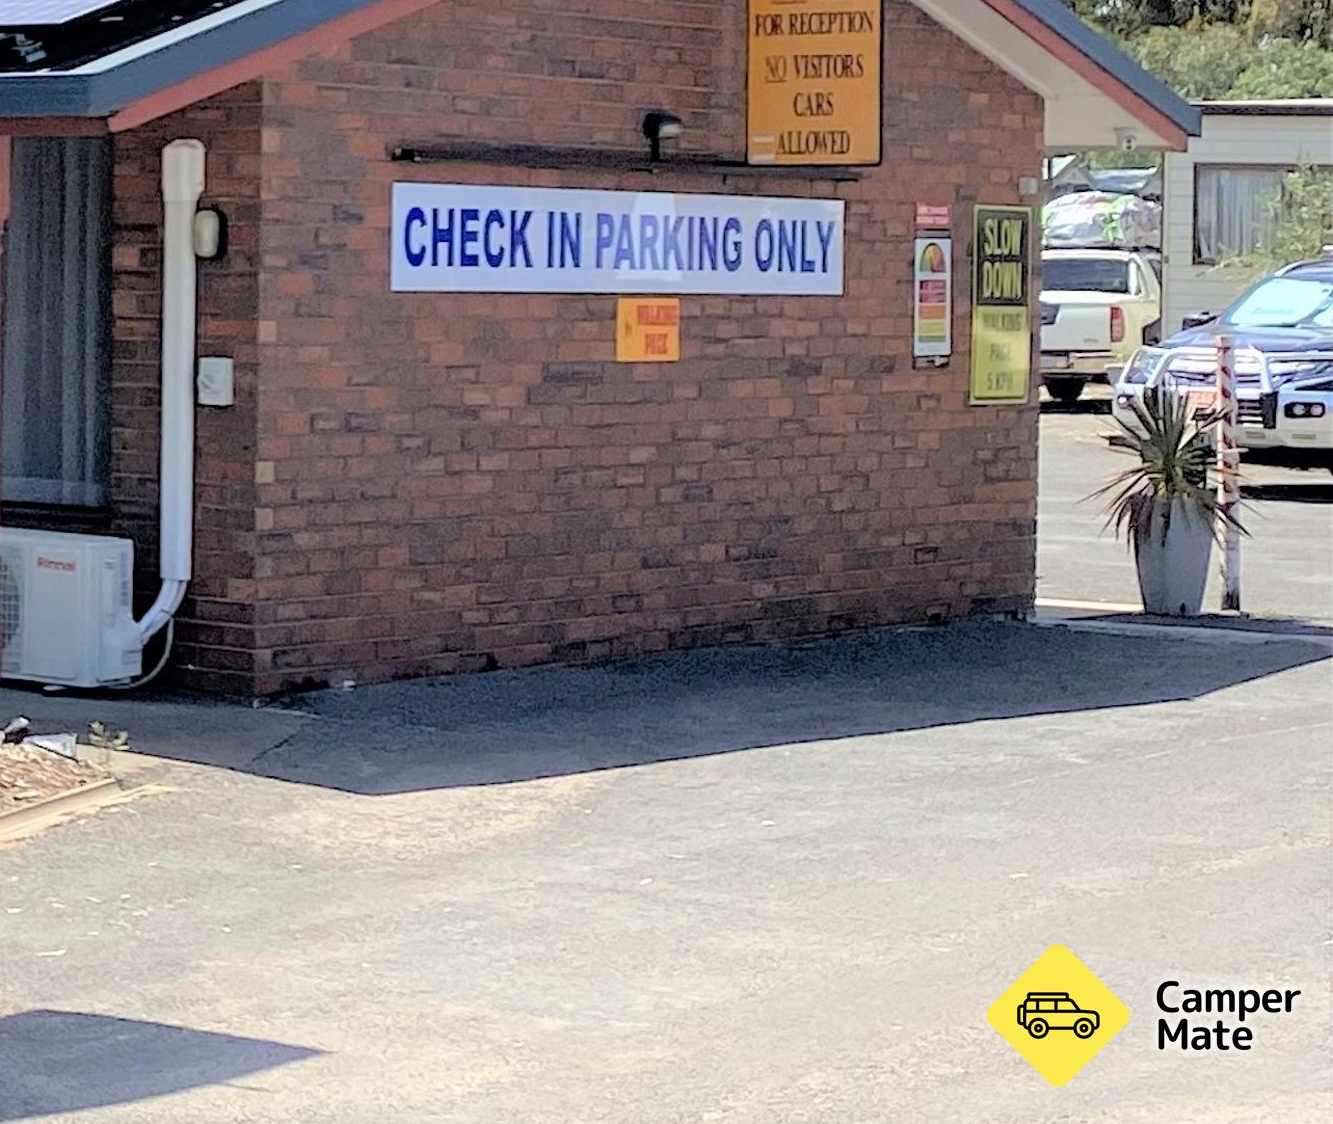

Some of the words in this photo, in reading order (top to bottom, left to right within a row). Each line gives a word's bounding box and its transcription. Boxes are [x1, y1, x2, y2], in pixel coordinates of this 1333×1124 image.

[755, 13, 785, 37] FOR
[788, 11, 876, 37] RECEPTION
[765, 55, 787, 79] NO
[793, 54, 865, 79] VISITORS
[793, 92, 834, 116] CARS
[776, 130, 850, 155] ALLOWED
[403, 205, 534, 269] CHECK
[546, 209, 583, 270] IN
[595, 212, 742, 274] PARKING
[754, 217, 836, 274] ONLY
[984, 218, 1023, 256] SLOW
[983, 261, 1023, 300] DOWN
